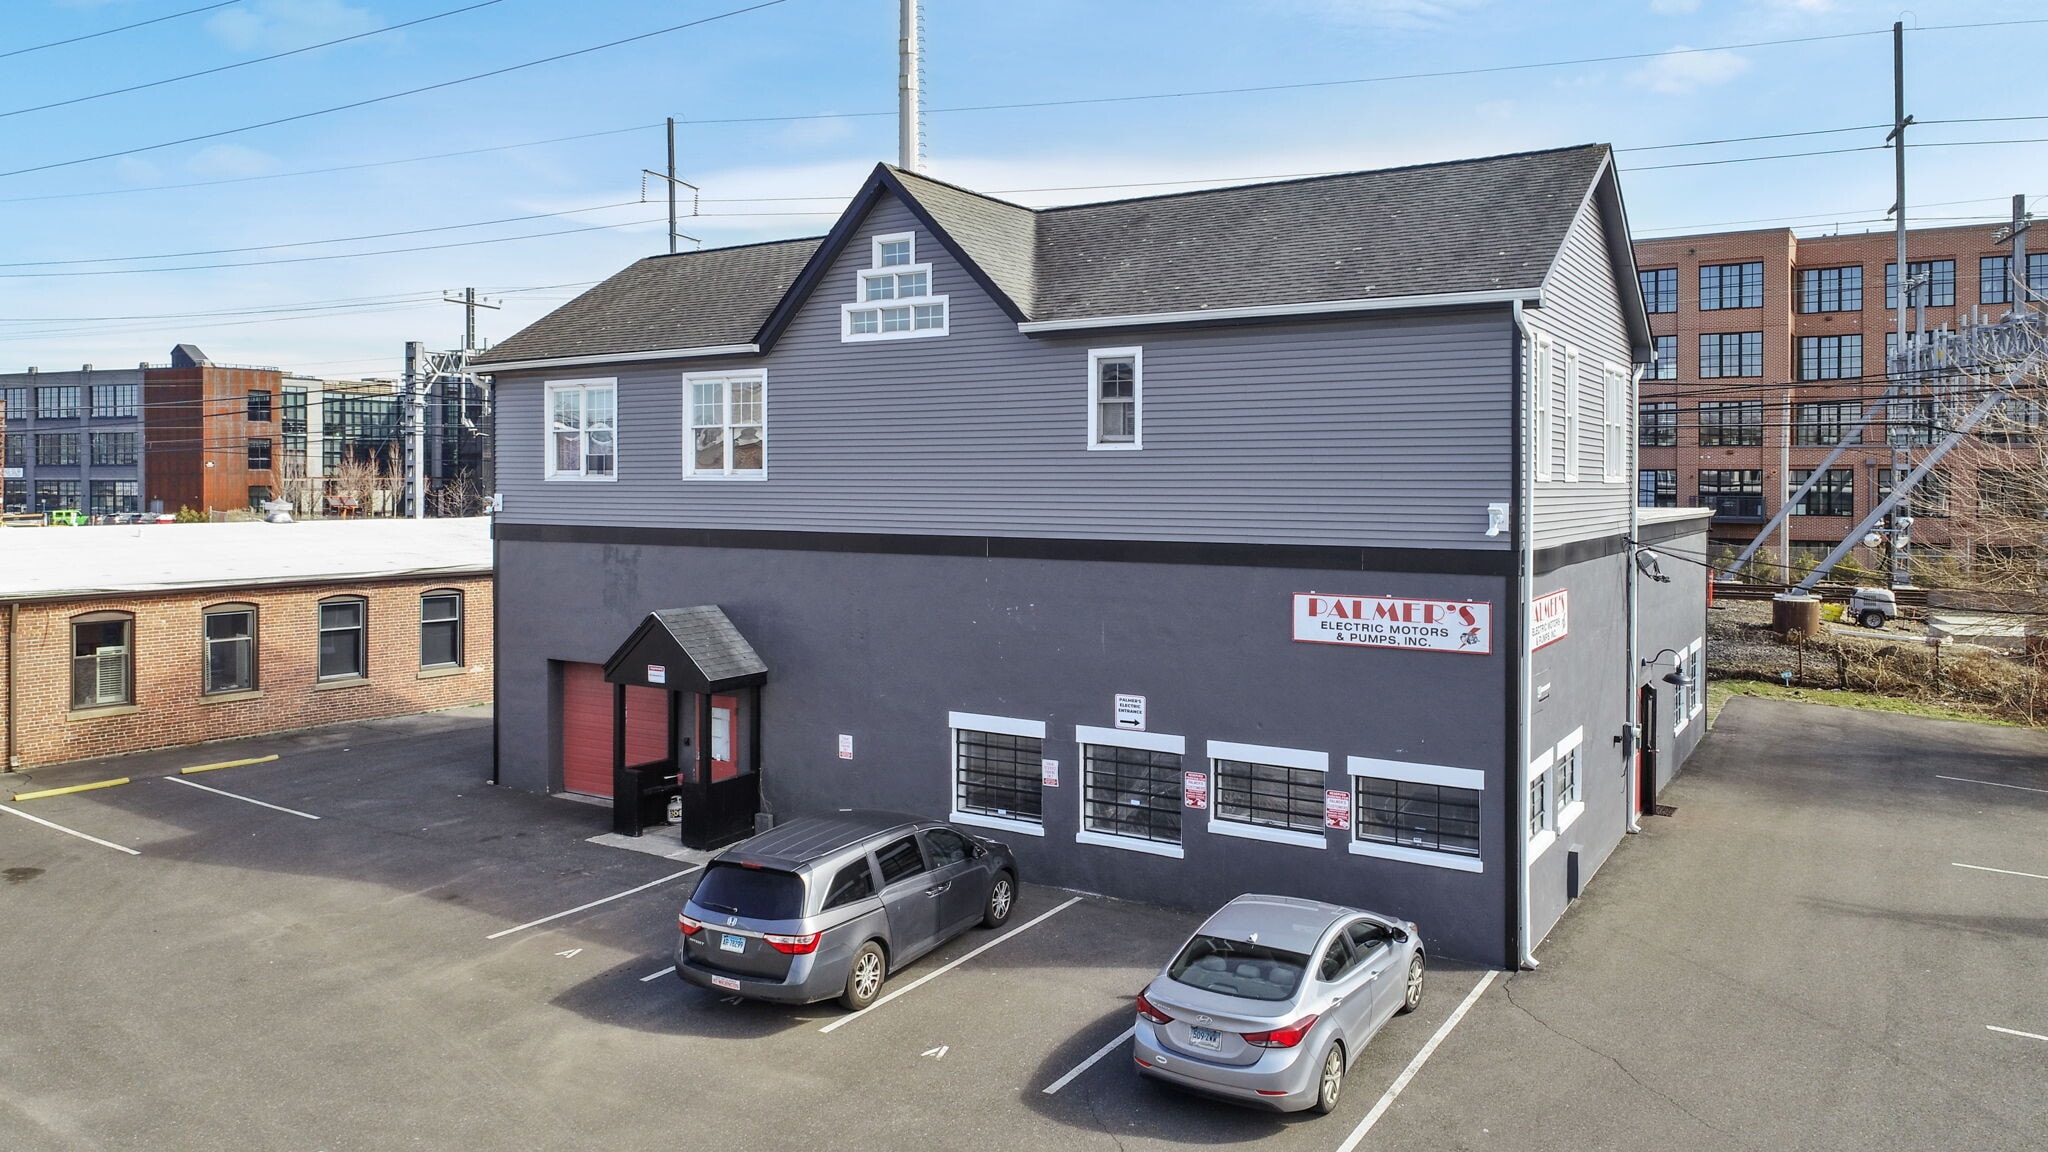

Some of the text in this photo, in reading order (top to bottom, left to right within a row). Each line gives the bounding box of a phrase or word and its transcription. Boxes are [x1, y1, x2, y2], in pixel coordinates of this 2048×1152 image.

[1308, 597, 1476, 627] PALMER'S
[1532, 594, 1565, 622] ALMER'S
[1321, 620, 1449, 637] ELECTRIC MOTORS
[1336, 632, 1432, 647] & PUMPS, INC.
